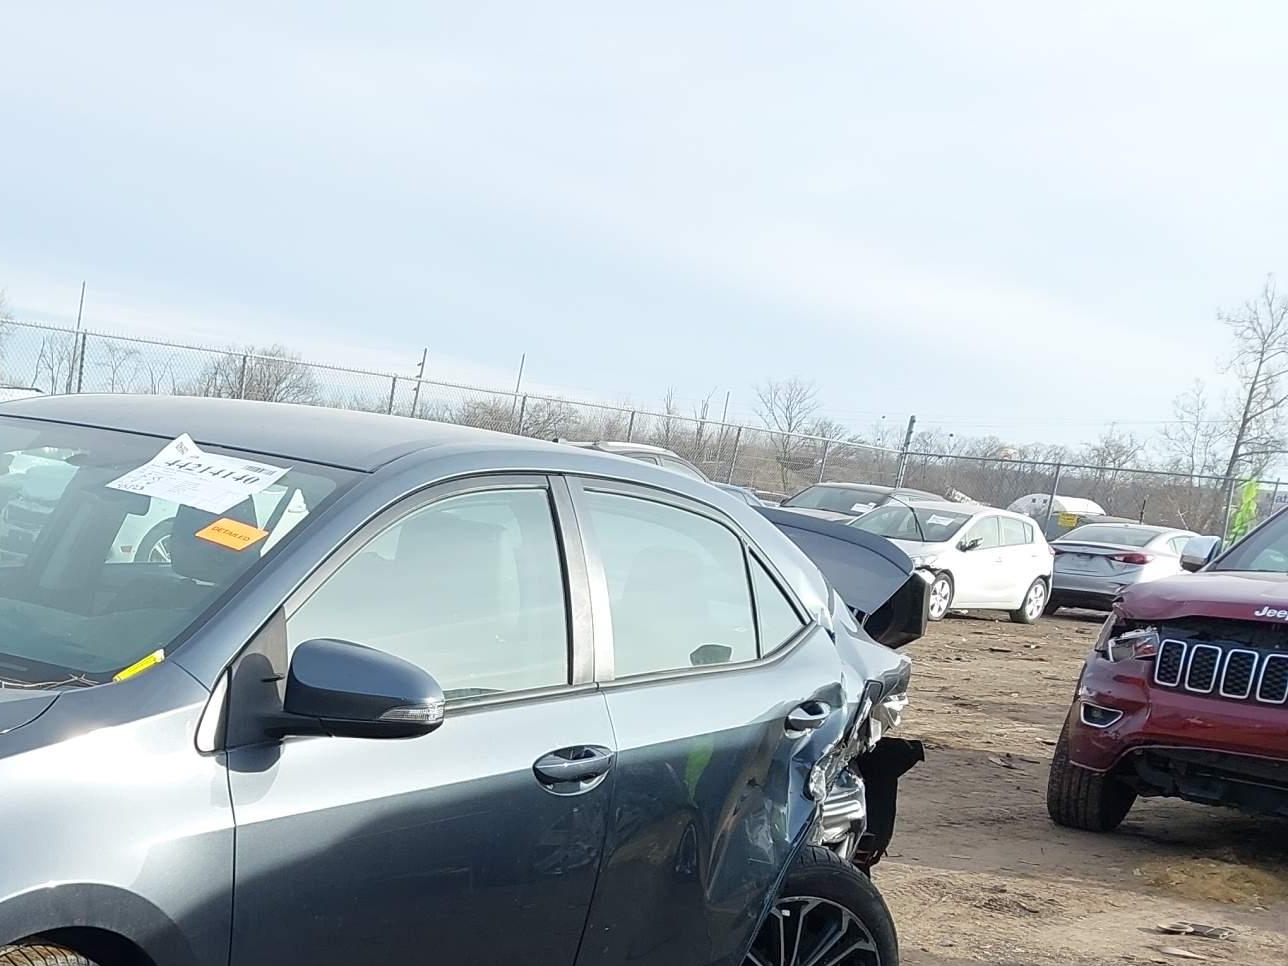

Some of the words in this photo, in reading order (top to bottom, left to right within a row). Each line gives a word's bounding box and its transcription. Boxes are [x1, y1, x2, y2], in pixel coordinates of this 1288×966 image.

[165, 460, 260, 484] 44214140
[212, 526, 250, 541] DETAILED
[1255, 606, 1288, 620] Jee
